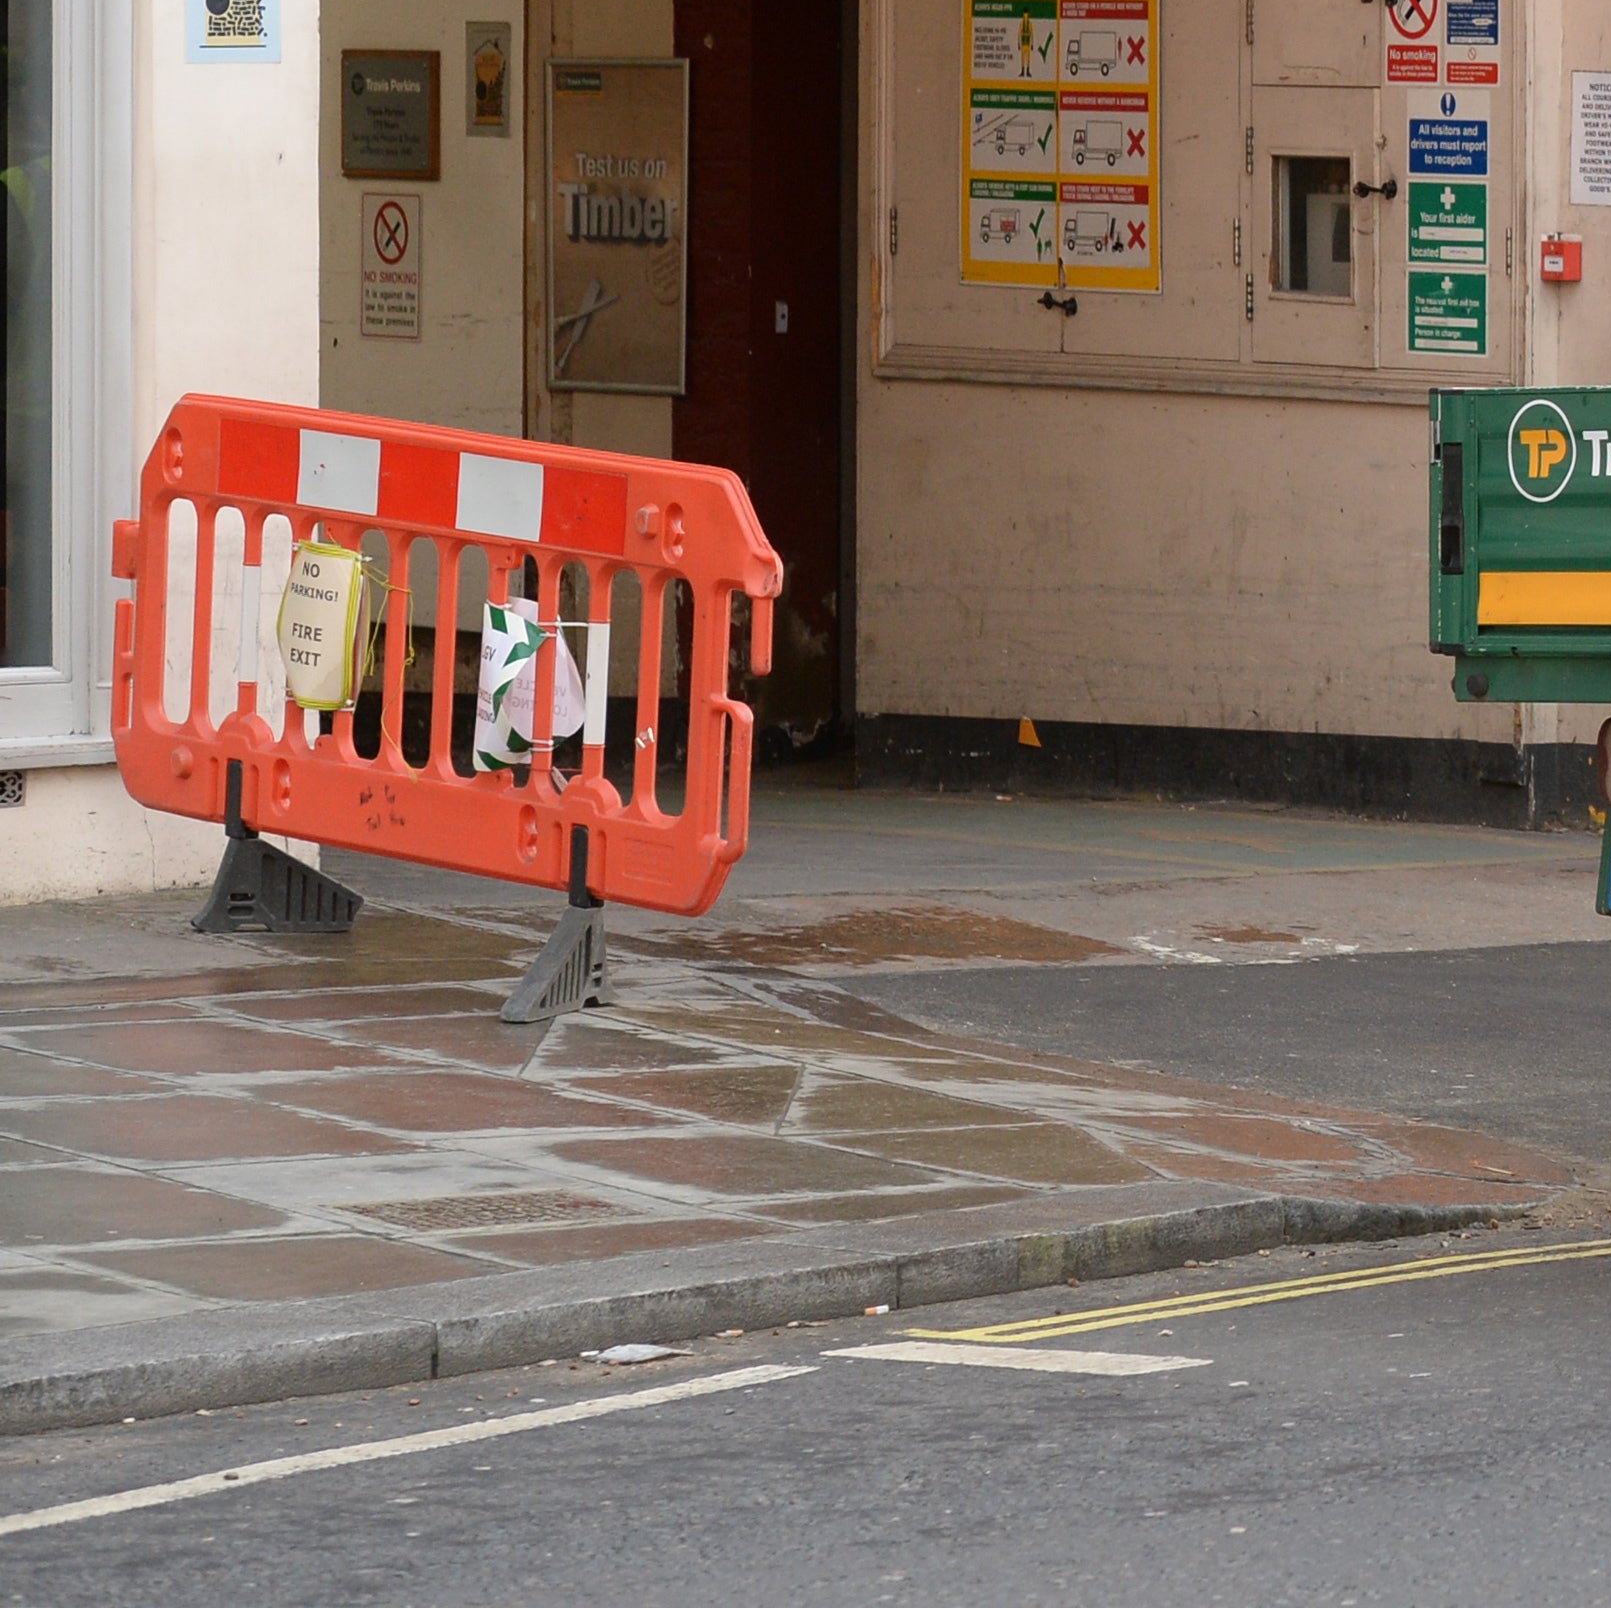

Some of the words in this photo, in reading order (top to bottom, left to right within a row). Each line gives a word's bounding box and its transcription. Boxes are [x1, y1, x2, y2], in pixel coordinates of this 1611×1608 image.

[1390, 49, 1401, 60] No
[1402, 49, 1436, 63] smoking
[1418, 124, 1430, 136] All
[1431, 125, 1461, 136] visitors
[1463, 126, 1478, 137] and
[1411, 138, 1438, 150] drivers
[1439, 139, 1460, 151] must
[1461, 140, 1486, 153] report
[576, 153, 613, 178] Test
[618, 158, 640, 179] us
[644, 158, 668, 179] on
[1424, 153, 1433, 165] to
[1434, 155, 1472, 167] reception
[557, 182, 678, 242] Timber
[1420, 212, 1438, 224] Your
[1439, 212, 1454, 224] first
[1456, 214, 1477, 224] aider
[1411, 246, 1440, 258] located
[364, 271, 376, 283] NO
[379, 272, 417, 285] SMOKING
[1520, 428, 1567, 478] TP
[302, 561, 320, 578] NO
[290, 582, 339, 602] PARKING!
[292, 622, 323, 642] FIRE
[290, 648, 321, 667] EXIT
